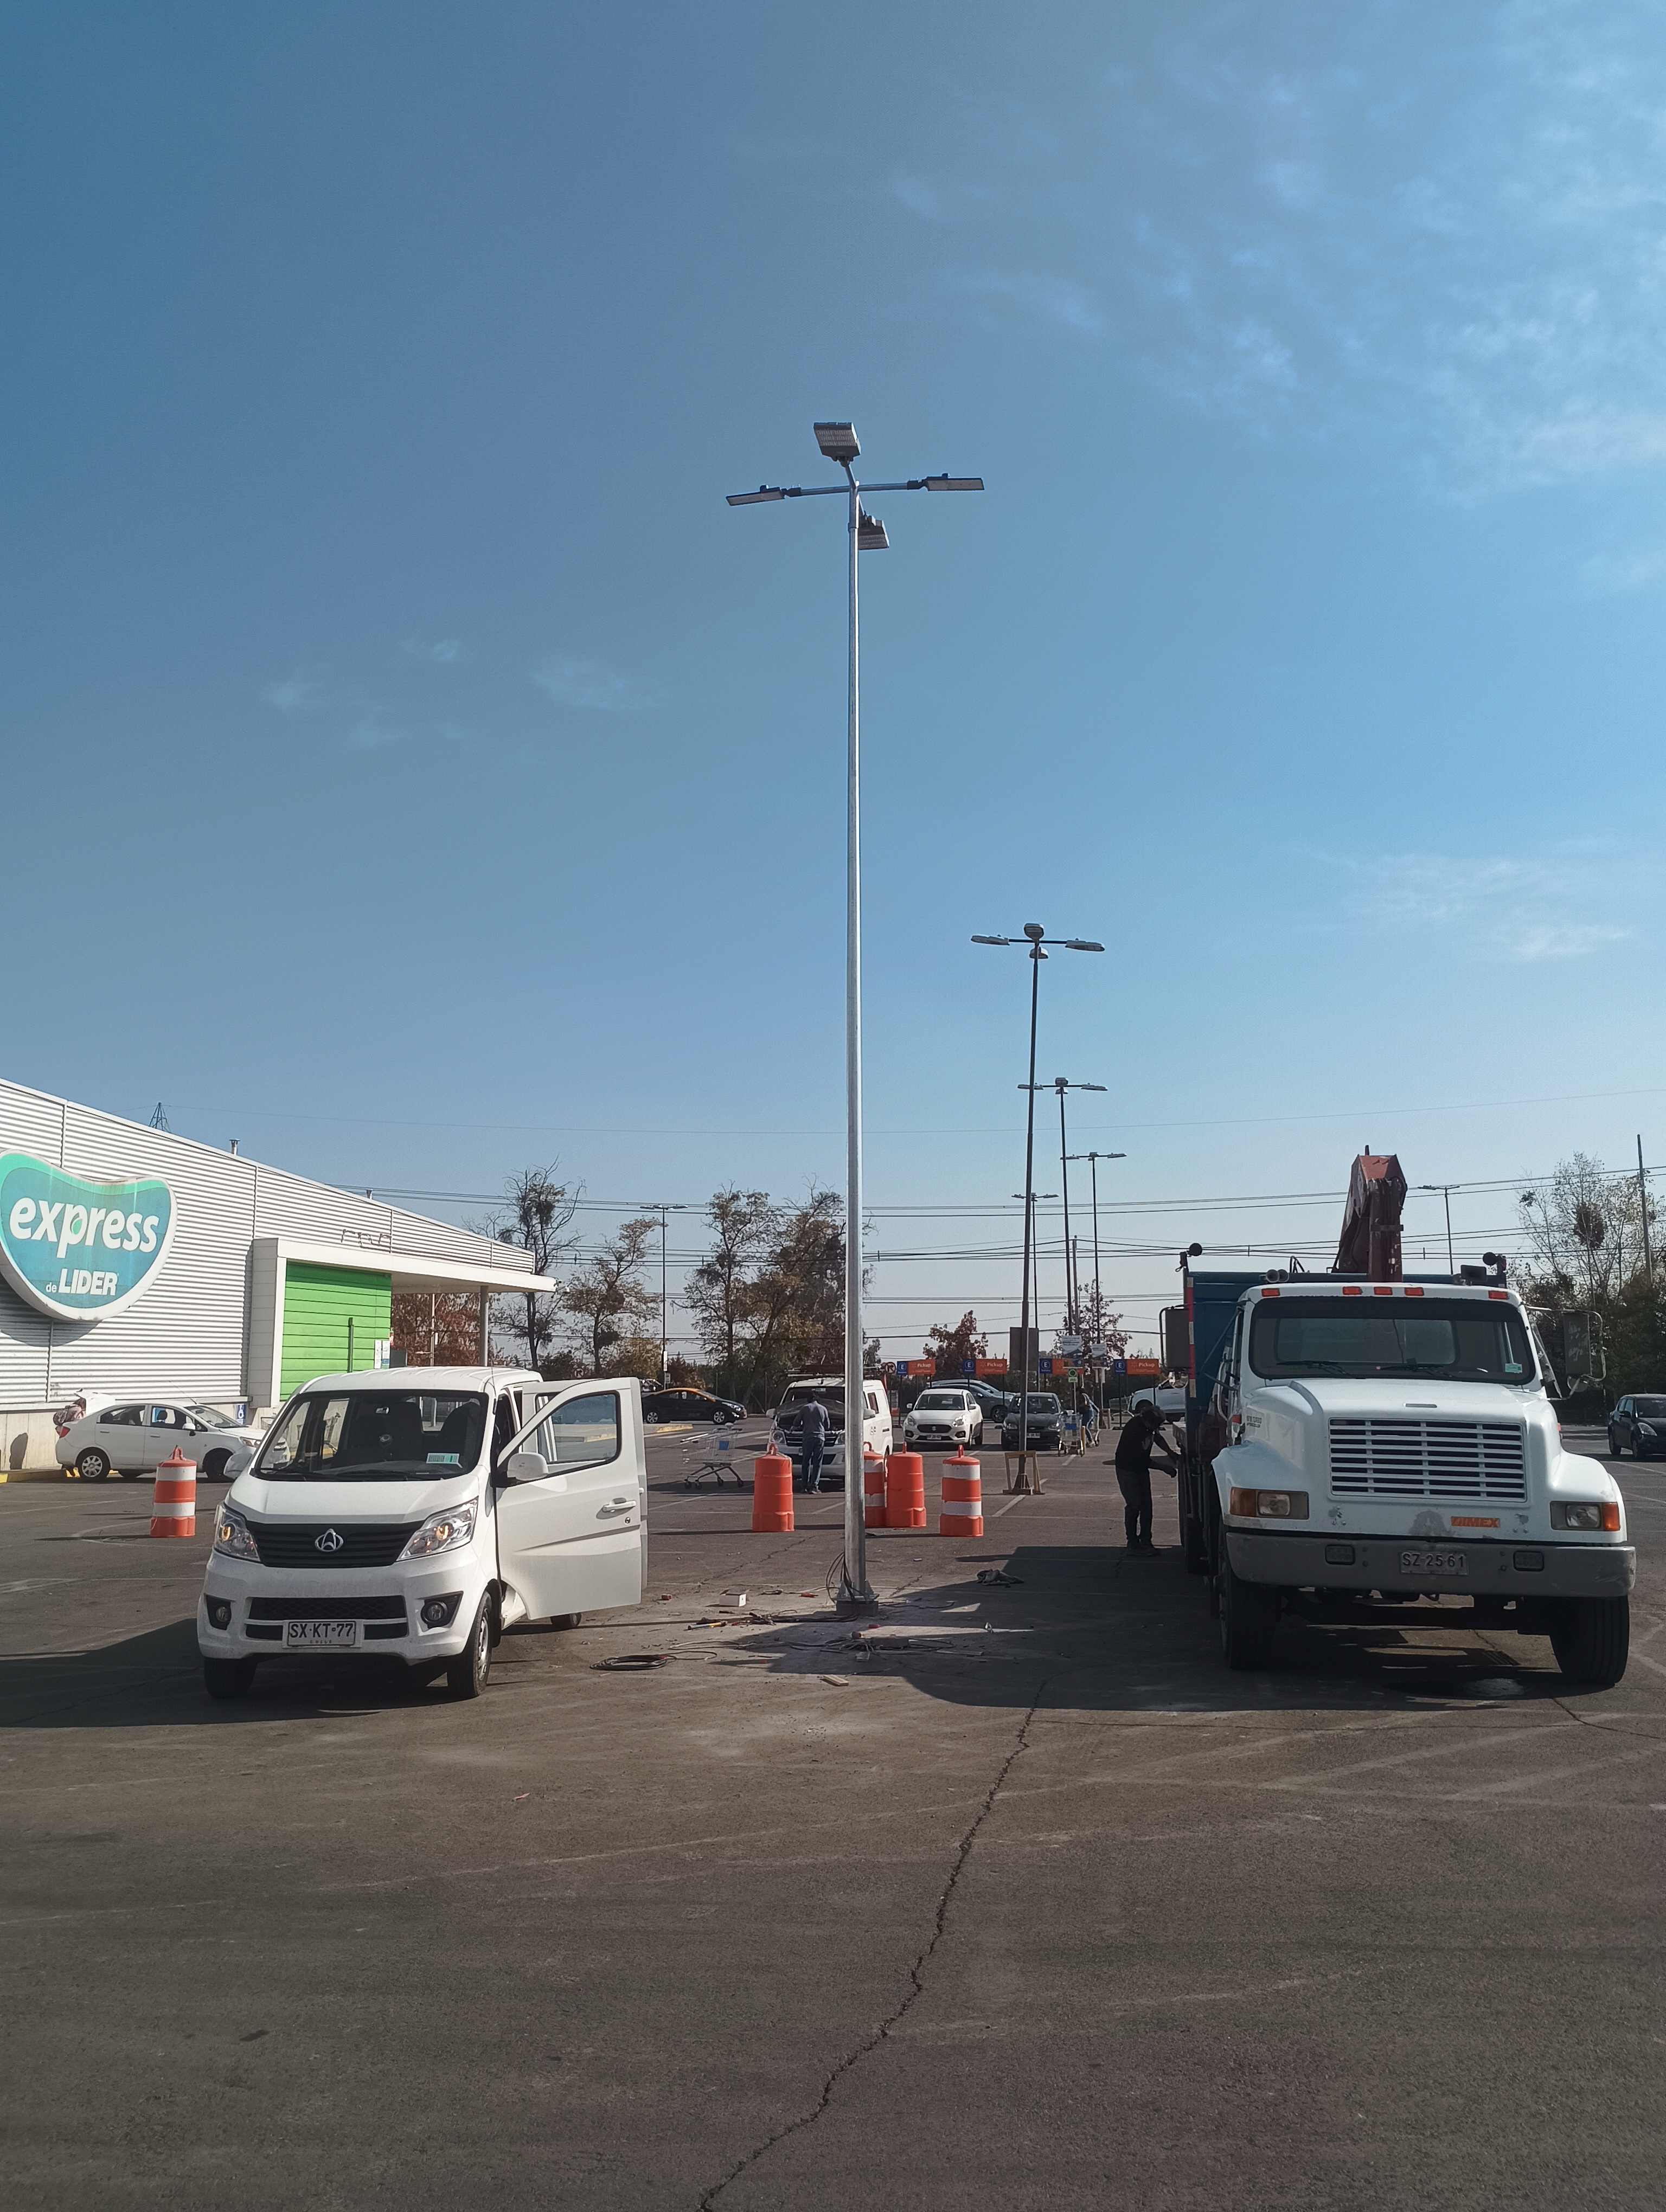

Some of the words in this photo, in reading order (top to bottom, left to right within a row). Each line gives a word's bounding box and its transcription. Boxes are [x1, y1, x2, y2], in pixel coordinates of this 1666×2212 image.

[9, 1197, 159, 1258] express
[46, 1282, 57, 1293] de
[58, 1268, 118, 1296] LIDER
